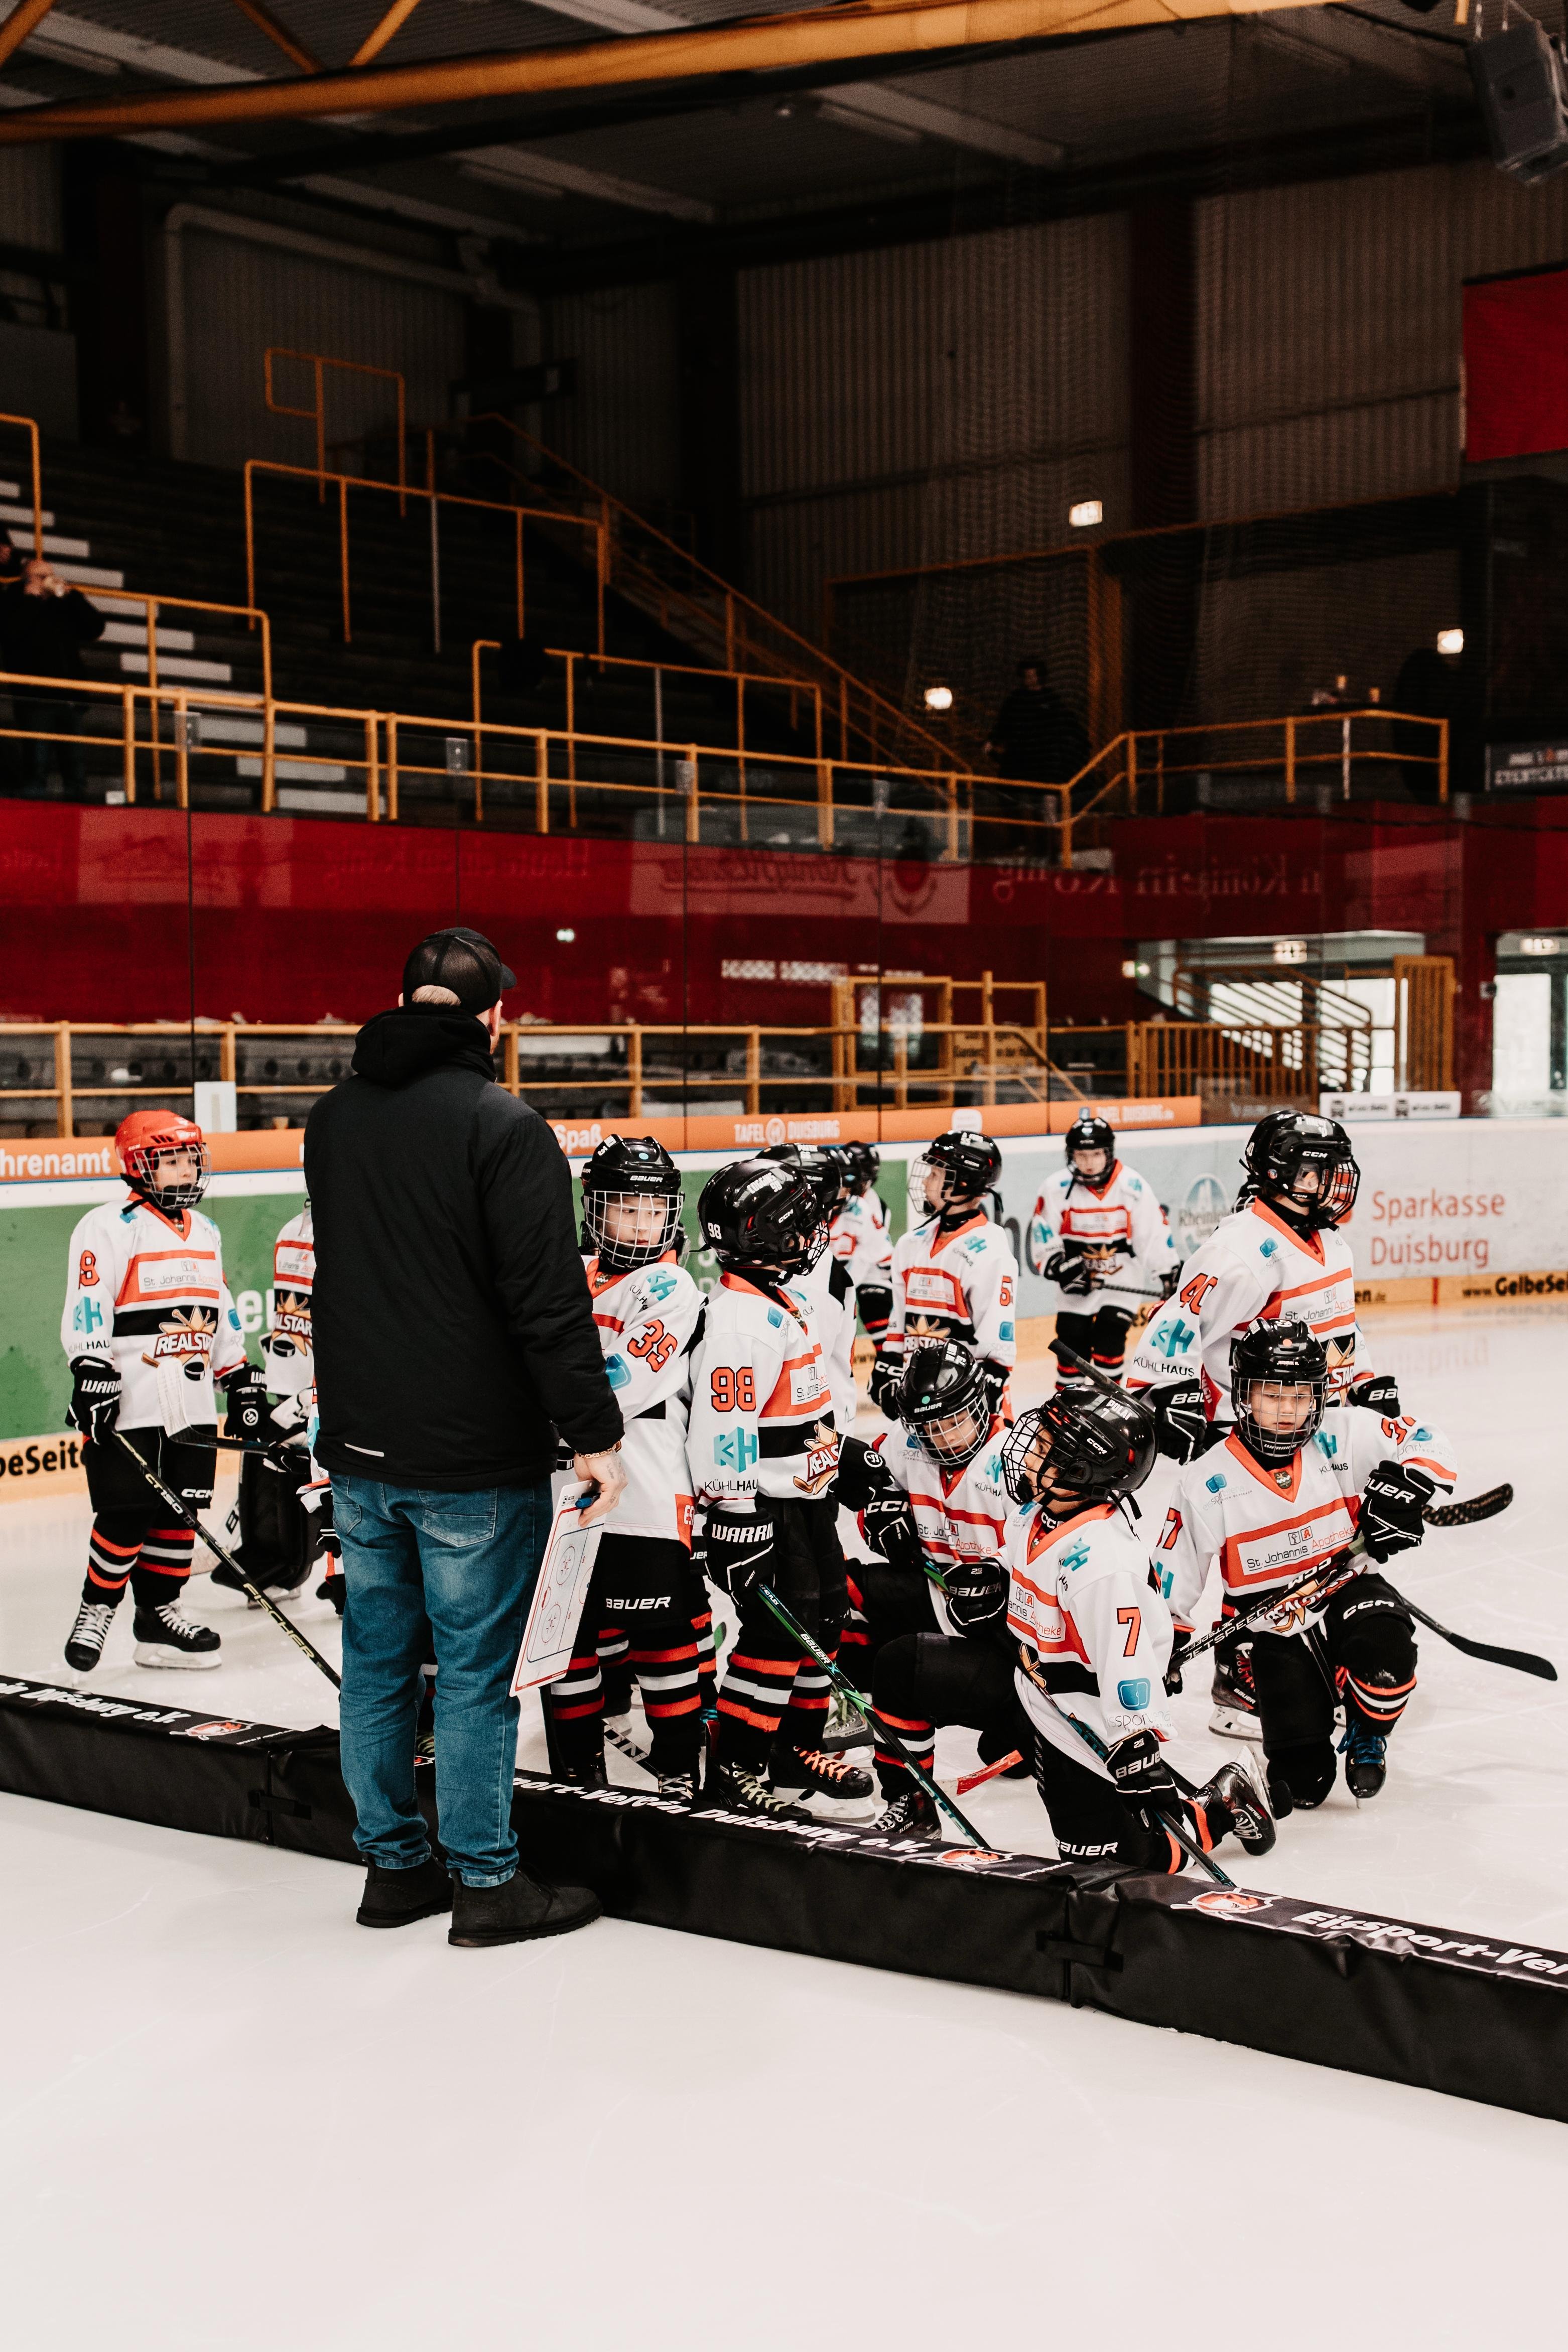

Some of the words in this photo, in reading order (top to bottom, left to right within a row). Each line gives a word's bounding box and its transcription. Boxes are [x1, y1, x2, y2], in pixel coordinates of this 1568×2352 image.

[554, 1123, 603, 1153] Spaß
[734, 1123, 765, 1143] TAFEL
[788, 1120, 840, 1140] DUISBURG
[769, 1180, 782, 1193] 98
[778, 1209, 794, 1224] CCM
[1372, 1188, 1505, 1226] Sparkasse
[708, 1222, 722, 1240] 98
[1371, 1233, 1489, 1269] Duisburg
[627, 1319, 678, 1373] 35
[1133, 1356, 1195, 1377] KÜHLHAUS
[711, 1366, 757, 1412] 98
[914, 1402, 942, 1413] BAUER
[1100, 1407, 1110, 1418] 7
[1106, 1399, 1133, 1420] POLAT
[1087, 1438, 1107, 1455] CCM
[1247, 1558, 1264, 1569] St.
[1264, 1545, 1309, 1564] Johannis
[1311, 1526, 1355, 1551] Apotheke
[744, 1570, 755, 1587] COVERT
[1284, 1556, 1332, 1593] CCM
[605, 1596, 671, 1610] BAUER
[768, 1593, 779, 1606] FLEX
[1343, 1599, 1395, 1621] CCM
[242, 1583, 315, 1659] FISCHER
[1117, 1607, 1141, 1657] 7
[1184, 1606, 1269, 1662] JETSPEED
[800, 1633, 831, 1664] BAUER
[828, 1664, 840, 1675] X
[28, 1687, 142, 1719] Duisburg
[133, 1709, 192, 1724] e.V.
[1233, 1687, 1256, 1705] BAUER
[845, 1726, 866, 1736] EASTON
[688, 1808, 859, 1843] Duisburg
[858, 1835, 932, 1854] e.V.
